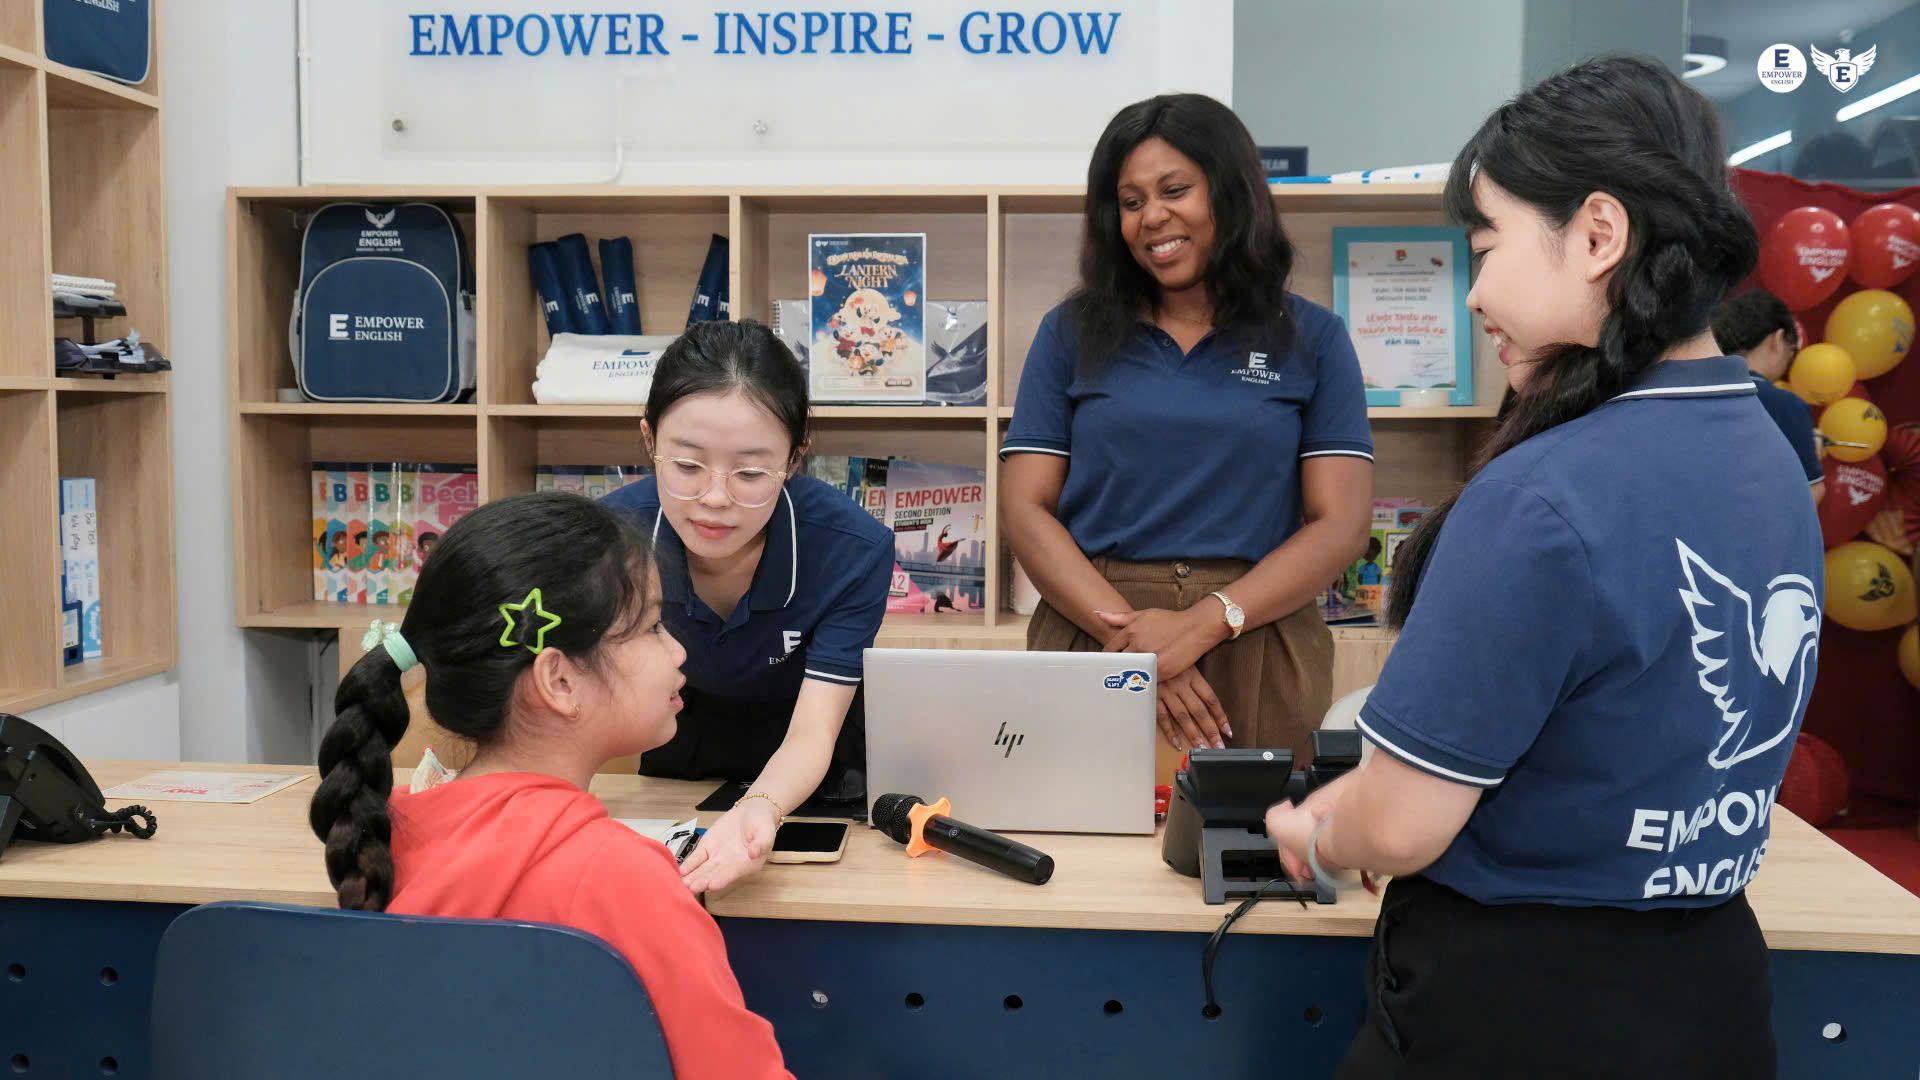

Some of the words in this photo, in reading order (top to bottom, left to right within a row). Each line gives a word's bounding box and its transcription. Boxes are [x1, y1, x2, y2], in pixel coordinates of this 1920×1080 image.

[408, 13, 670, 57] EMPOWER
[713, 12, 912, 55] INSPIRE
[959, 11, 1122, 55] GROW
[361, 230, 399, 238] EMPOWER
[358, 238, 402, 247] ENGLISH
[834, 264, 898, 279] LANTERN
[845, 275, 889, 291] NIGHT
[585, 292, 599, 305] E
[621, 292, 635, 305] E
[697, 294, 711, 307] E
[546, 300, 560, 313] E
[719, 302, 730, 313] E
[328, 313, 350, 339] E
[355, 316, 425, 330] EMPOWER
[355, 330, 403, 341] ENGLISH
[1248, 351, 1268, 369] E
[1230, 368, 1281, 381] EMPOWER
[1241, 376, 1270, 385] ENGLISH
[895, 485, 982, 509] EMPOWER
[894, 509, 922, 520] SECOND
[923, 507, 951, 517] EDITION
[994, 721, 1025, 758] hp
